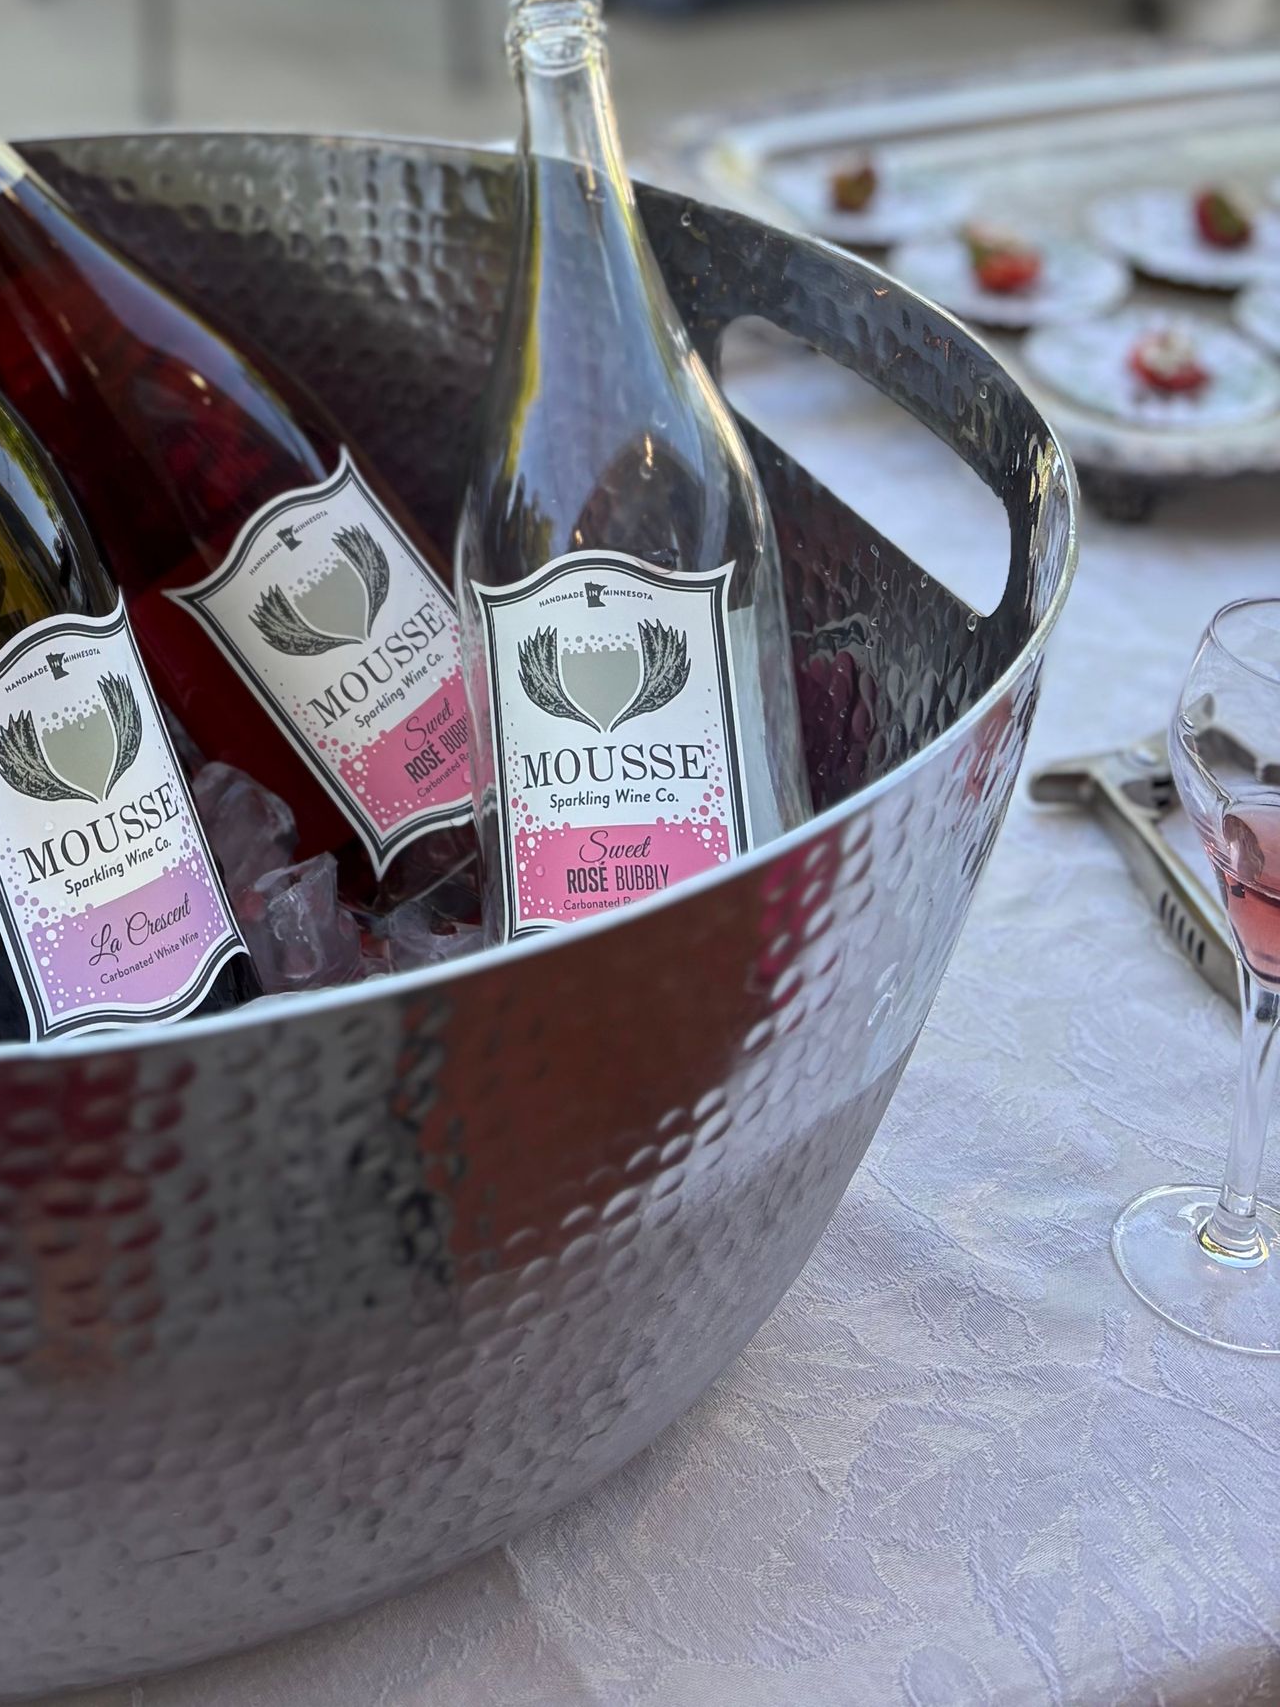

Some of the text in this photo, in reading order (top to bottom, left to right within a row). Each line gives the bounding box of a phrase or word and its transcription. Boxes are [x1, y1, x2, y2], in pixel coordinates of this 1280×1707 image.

[249, 542, 282, 575] HANDMADE
[294, 510, 328, 534] MINNESOTA
[539, 591, 584, 607] HANDMADE
[603, 590, 653, 600] MINNESOTA
[5, 665, 48, 693] HANDMADE
[63, 648, 100, 663] MINNESOTA
[306, 602, 447, 729] MOUSSE
[355, 652, 445, 729] Sparkling Wine Co.
[405, 697, 453, 751] Sweet
[404, 739, 446, 784] ROSÉ
[417, 760, 460, 797] Carbonated
[522, 744, 709, 789] MOUSSE
[550, 788, 679, 812] Sparkling Wine Co.
[18, 782, 180, 884] MOUSSE
[579, 830, 650, 863] Sweet
[64, 838, 171, 896] Sparkling Wine Co.
[567, 861, 669, 894] ROSÉ BUBBLY
[563, 898, 620, 910] Carbonated
[88, 893, 192, 966] La Crescent
[99, 930, 198, 985] Carbonated White Wine
